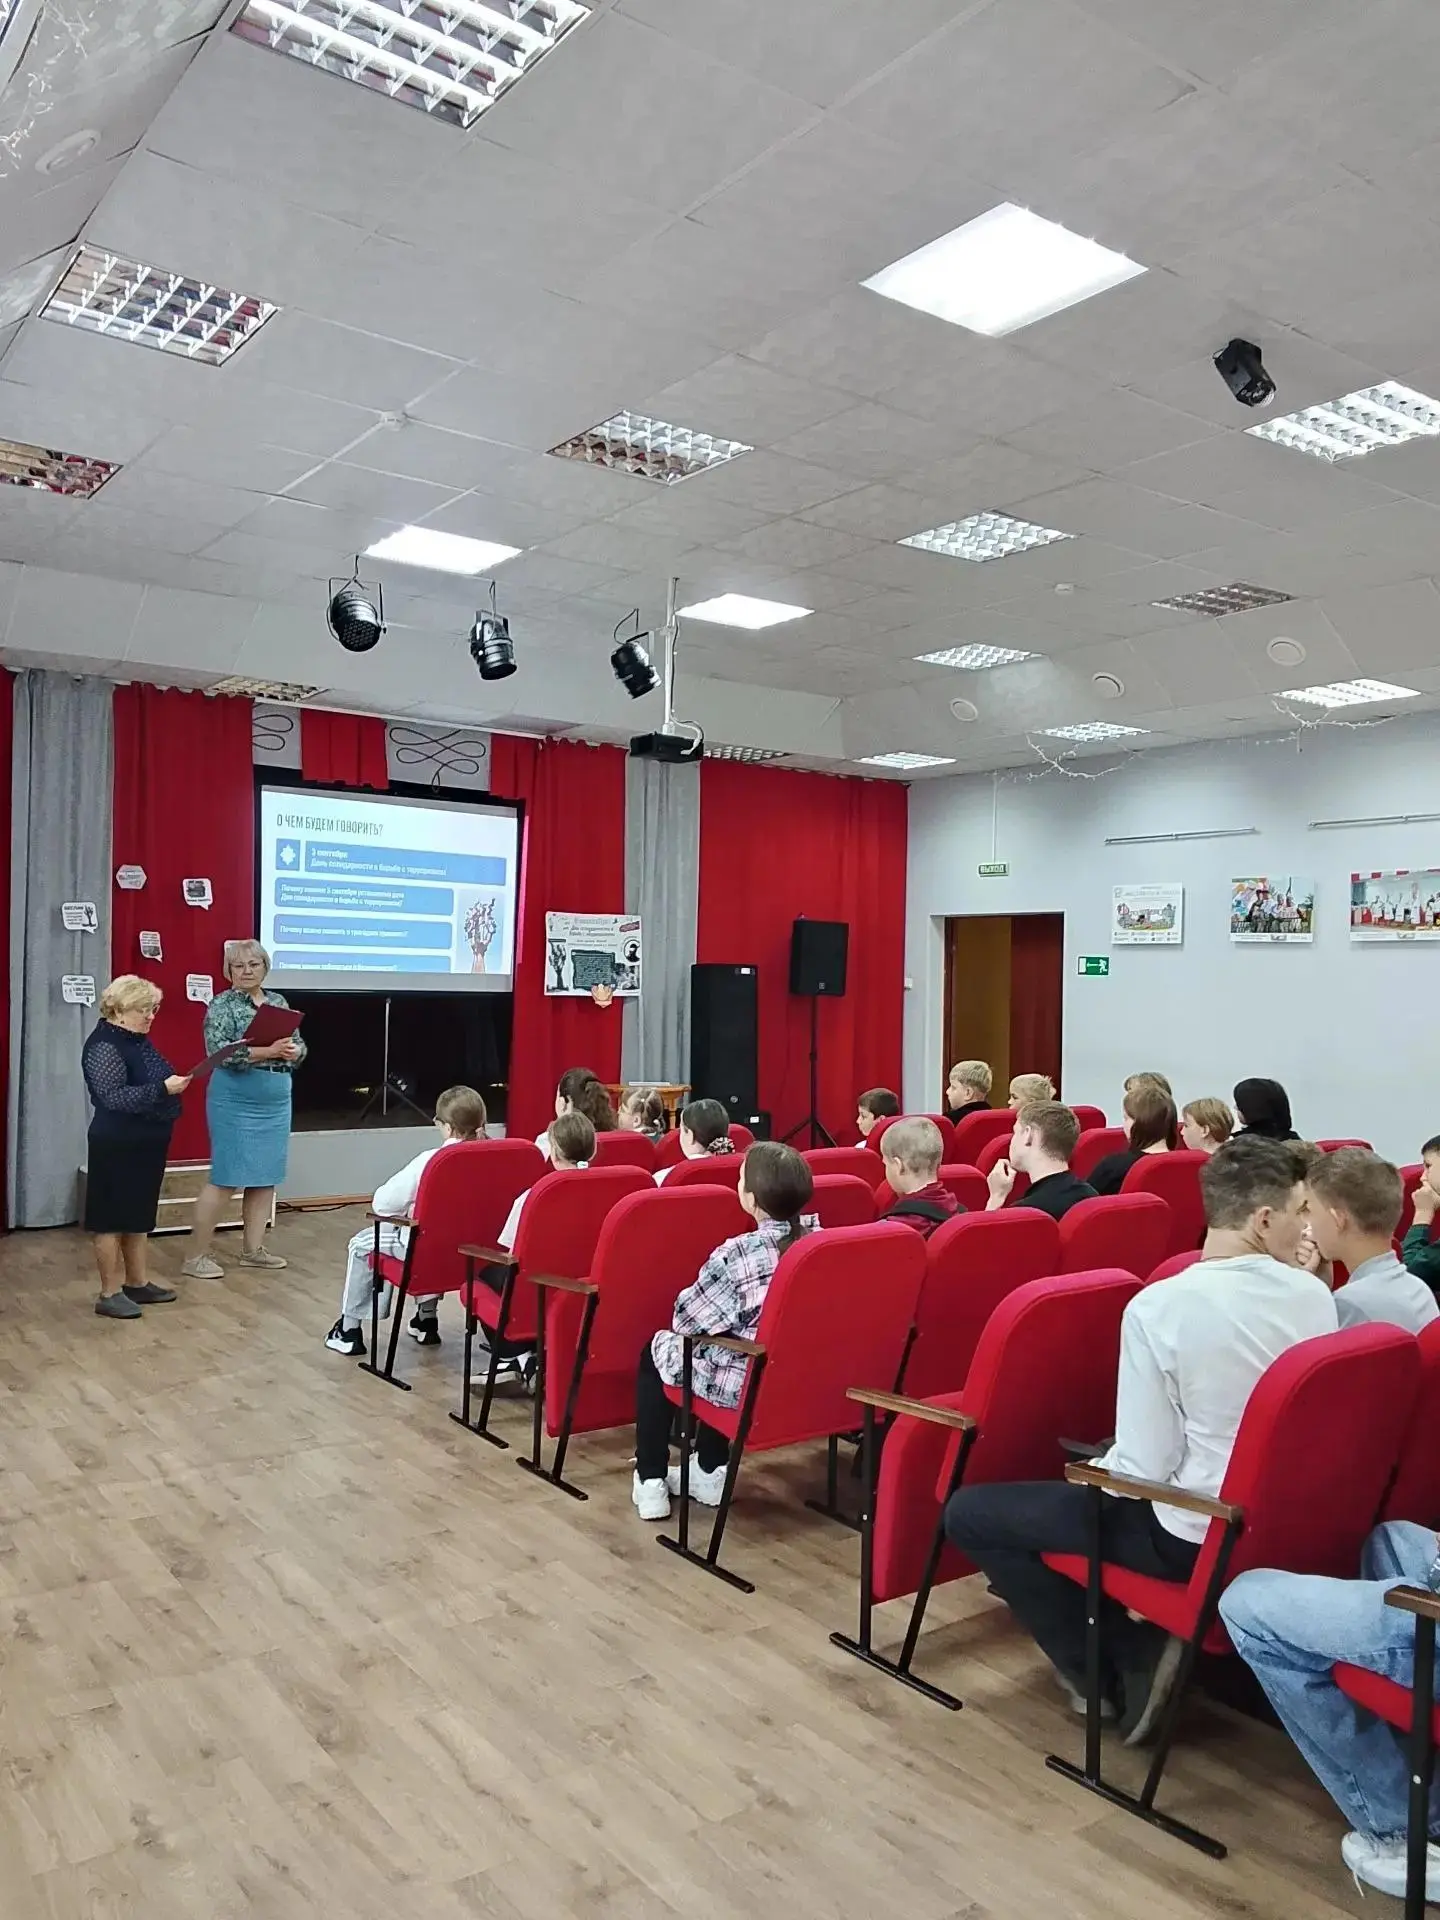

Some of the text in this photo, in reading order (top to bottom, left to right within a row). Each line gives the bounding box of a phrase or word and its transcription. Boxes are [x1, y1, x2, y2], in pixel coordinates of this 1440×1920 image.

[276, 813, 384, 836] О ЧЕМ БУДЕМ ГОВОРИТЬ?
[980, 864, 1005, 873] ВЫХОД
